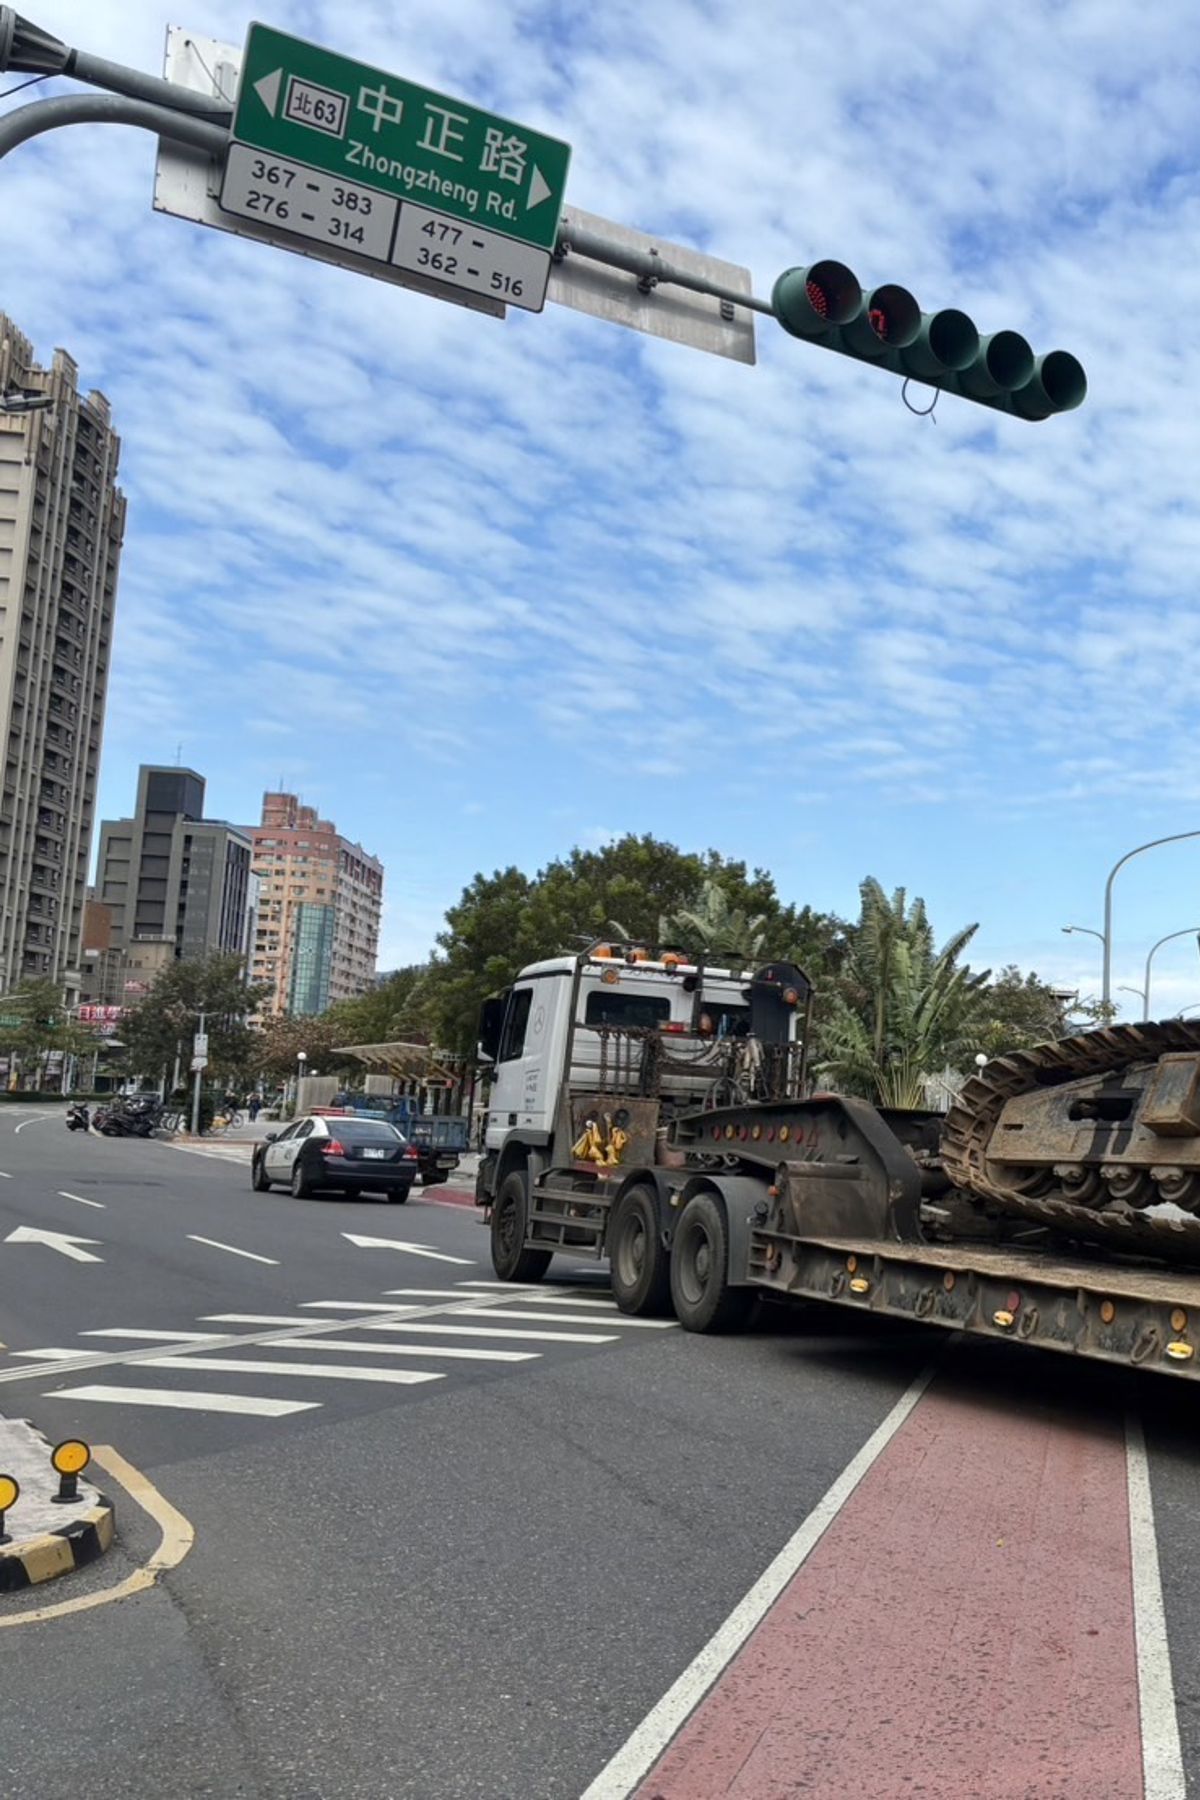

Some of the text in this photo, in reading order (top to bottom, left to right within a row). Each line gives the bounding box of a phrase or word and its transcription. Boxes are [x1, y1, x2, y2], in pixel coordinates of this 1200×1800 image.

[291, 92, 337, 126] 北63
[357, 84, 528, 186] 中正路
[251, 160, 297, 189] 367
[331, 187, 374, 216] 383
[345, 139, 519, 221] Zhongzheng Rd.
[245, 190, 290, 220] 276
[327, 217, 366, 245] 314
[421, 219, 464, 247] 477
[416, 247, 459, 277] 362
[488, 271, 525, 298] 516
